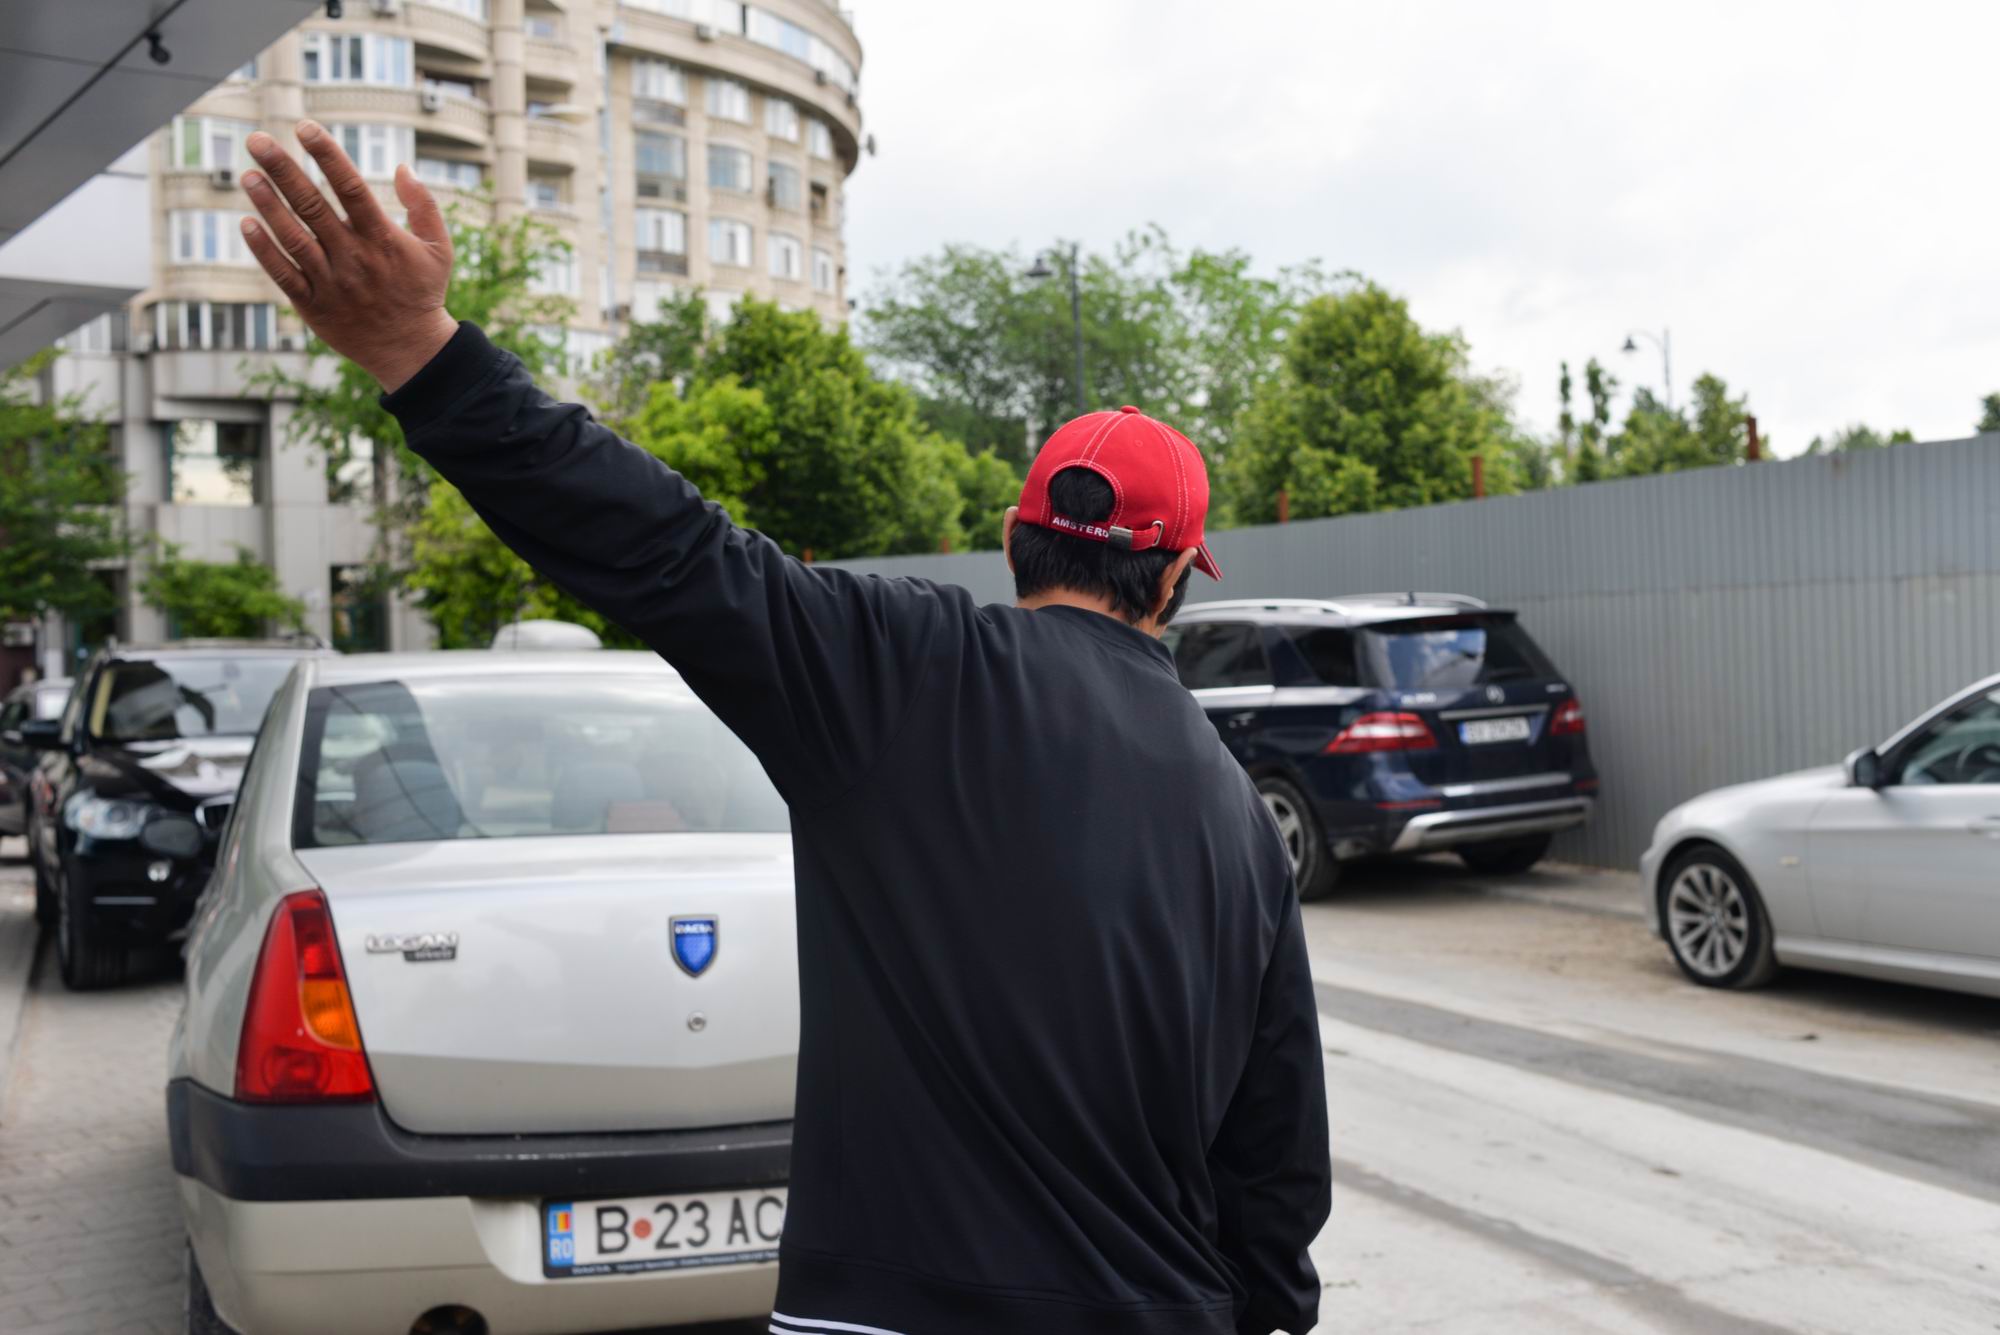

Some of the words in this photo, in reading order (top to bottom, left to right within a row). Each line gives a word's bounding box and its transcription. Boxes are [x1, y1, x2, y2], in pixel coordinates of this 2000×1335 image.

[365, 932, 459, 953] LOGAN
[596, 1205, 629, 1254] B
[654, 1201, 711, 1250] 23
[550, 1238, 571, 1261] RO
